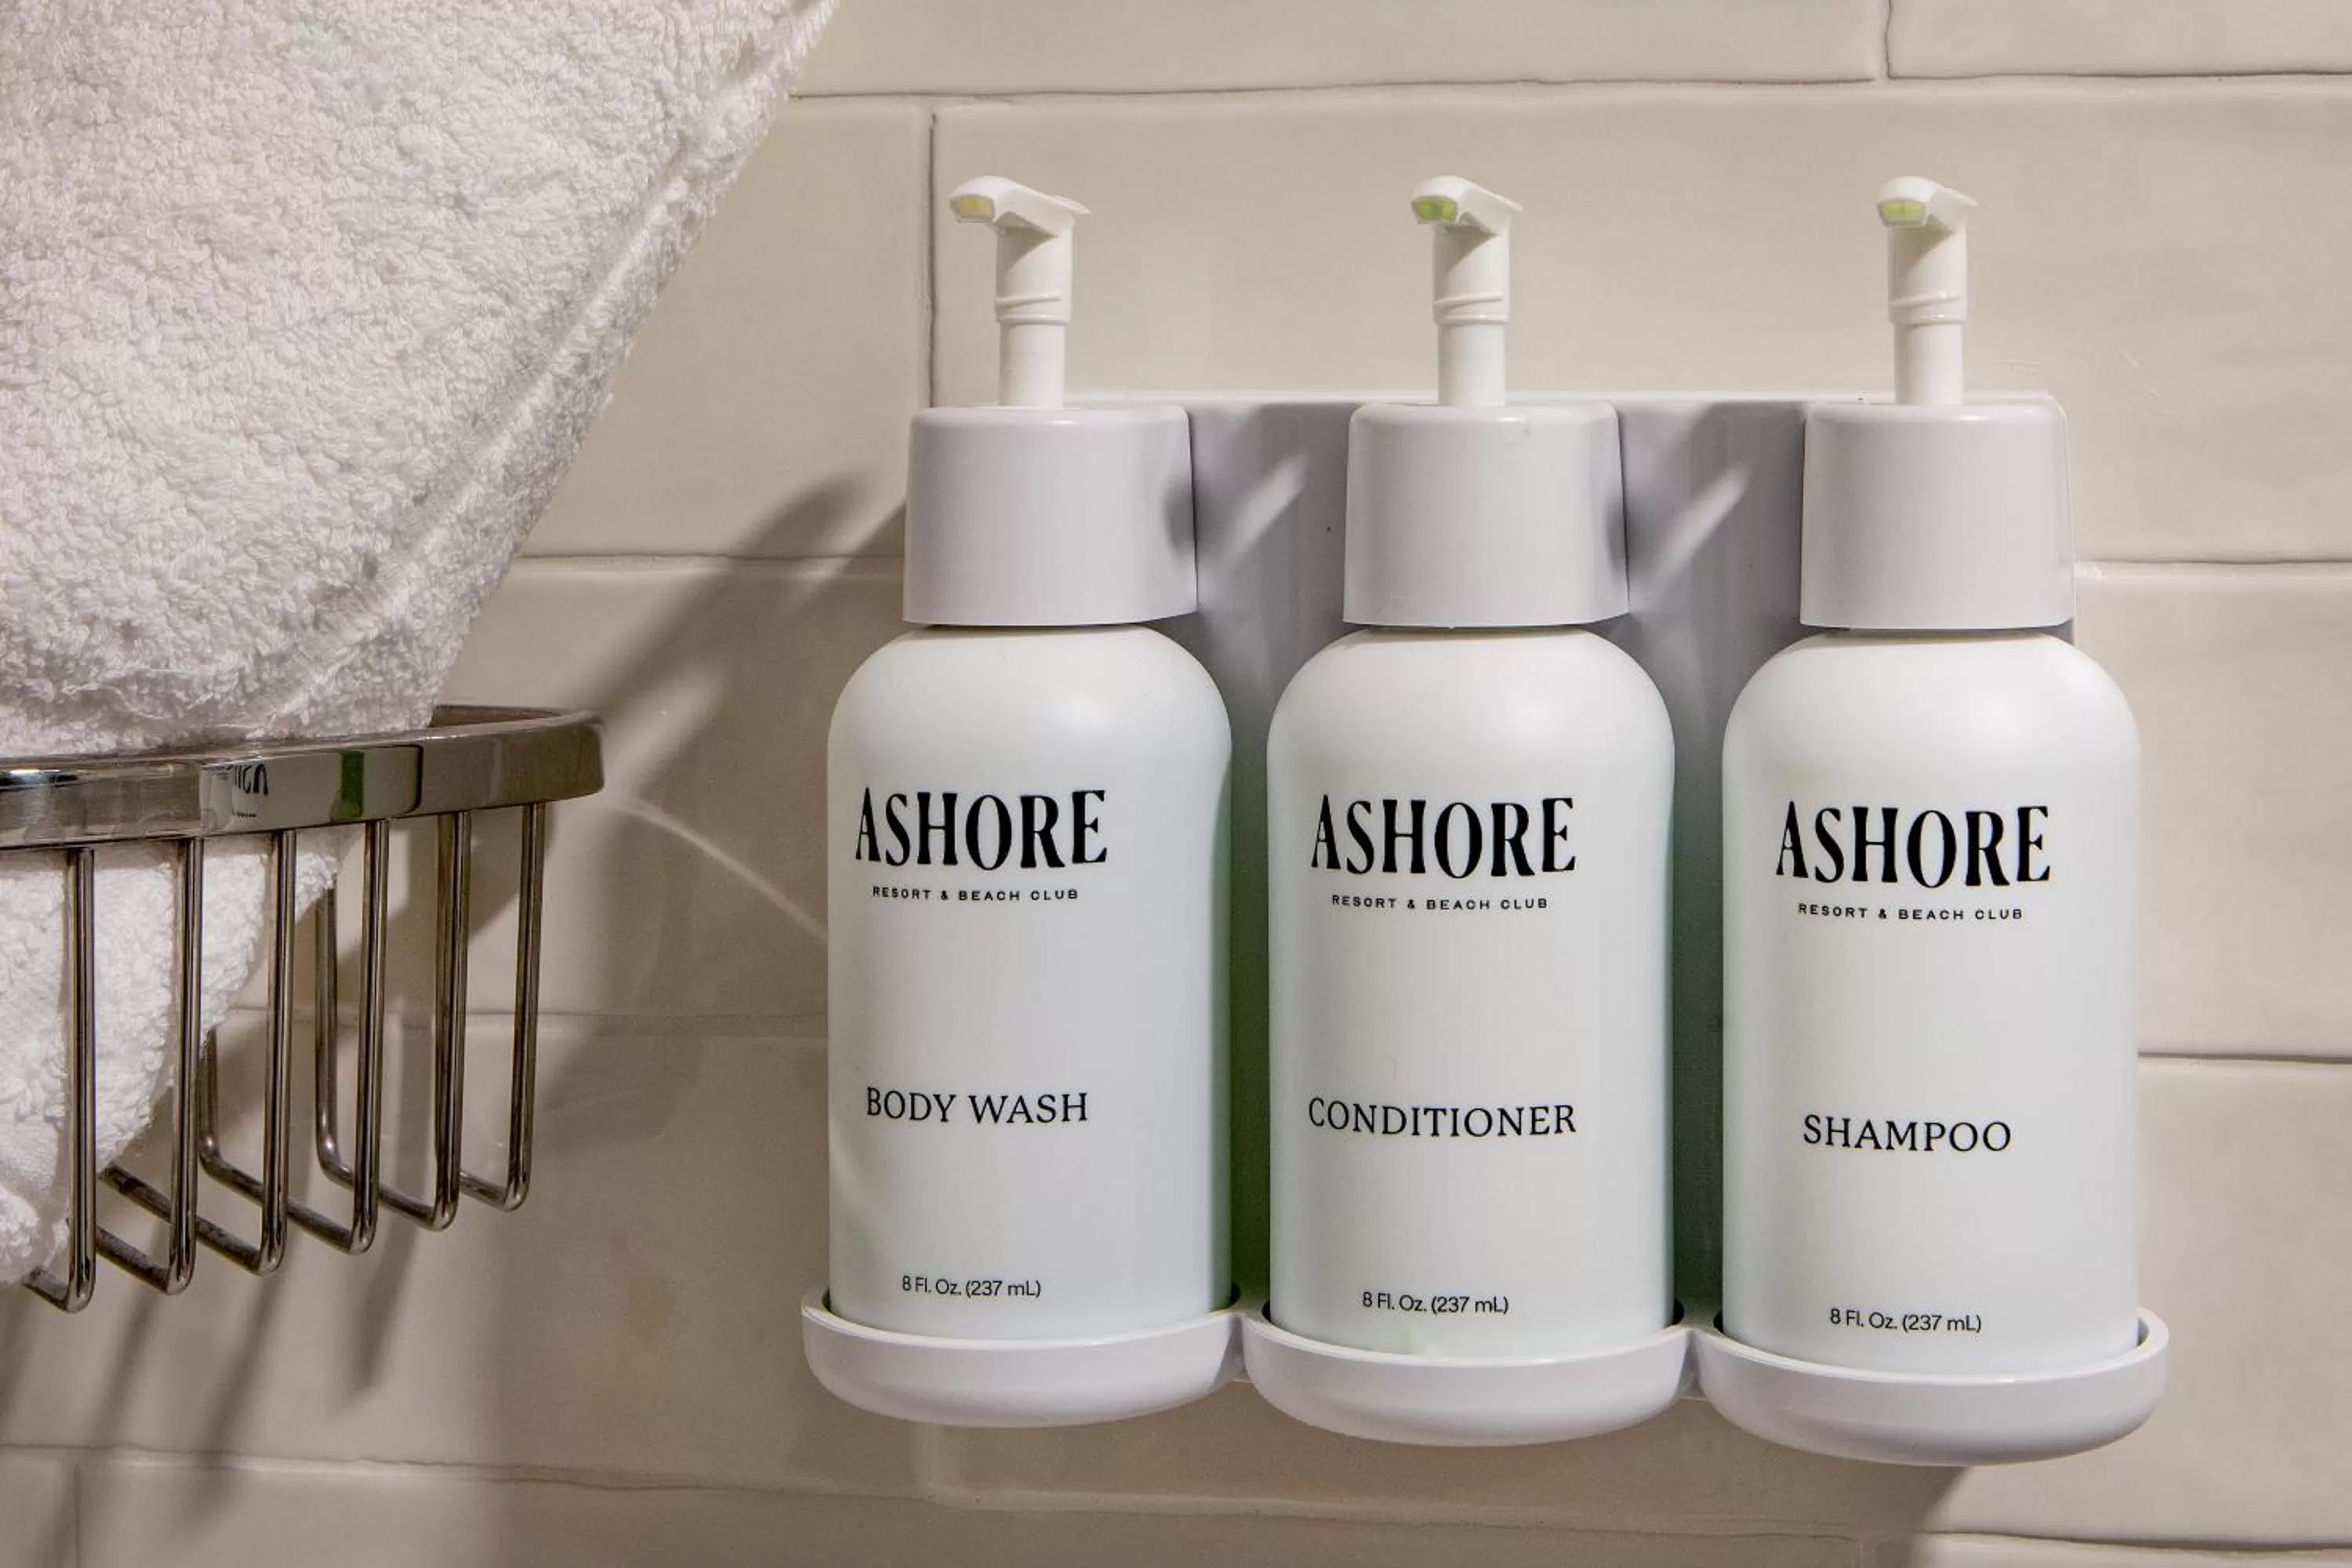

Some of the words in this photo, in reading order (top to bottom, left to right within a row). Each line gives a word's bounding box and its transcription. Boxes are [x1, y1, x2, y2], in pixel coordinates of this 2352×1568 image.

[855, 786, 1108, 871] ASHORE
[1310, 793, 1576, 879] ASHORE
[1775, 800, 2051, 889] ASHORE
[872, 885, 932, 900] RESORT
[940, 890, 949, 901] &
[958, 890, 1020, 902] BEACH
[1029, 888, 1078, 901] CLUB
[1331, 894, 1397, 909] RESORT
[1406, 898, 1416, 910] &
[1426, 899, 1490, 910] BEACH
[1500, 898, 1548, 910] CLUB
[1798, 902, 1868, 919] RESORT
[1878, 908, 1888, 920] &
[1898, 909, 1964, 920] BEACH
[1974, 909, 2022, 920] CLUB
[866, 1086, 957, 1123] BODY
[967, 1092, 1088, 1125] WASH
[1308, 1094, 1577, 1138] CONDITIONER
[1802, 1113, 2011, 1152] SHAMPOO
[902, 1274, 913, 1292] 8
[914, 1276, 932, 1294] Fl.
[935, 1278, 962, 1297] Oz.
[965, 1279, 1004, 1299] (237
[1007, 1279, 1042, 1298] mL)
[1362, 1290, 1374, 1308] 8
[1377, 1291, 1396, 1310] Fl.
[1398, 1294, 1428, 1312] Oz.
[1431, 1295, 1470, 1316] (237
[1475, 1296, 1509, 1315] mL)
[1829, 1307, 1842, 1325] 8
[1846, 1308, 1864, 1328] Fl.
[1868, 1311, 1898, 1330] Oz.
[1901, 1313, 1943, 1333] (237
[1947, 1315, 1982, 1334] mL)
